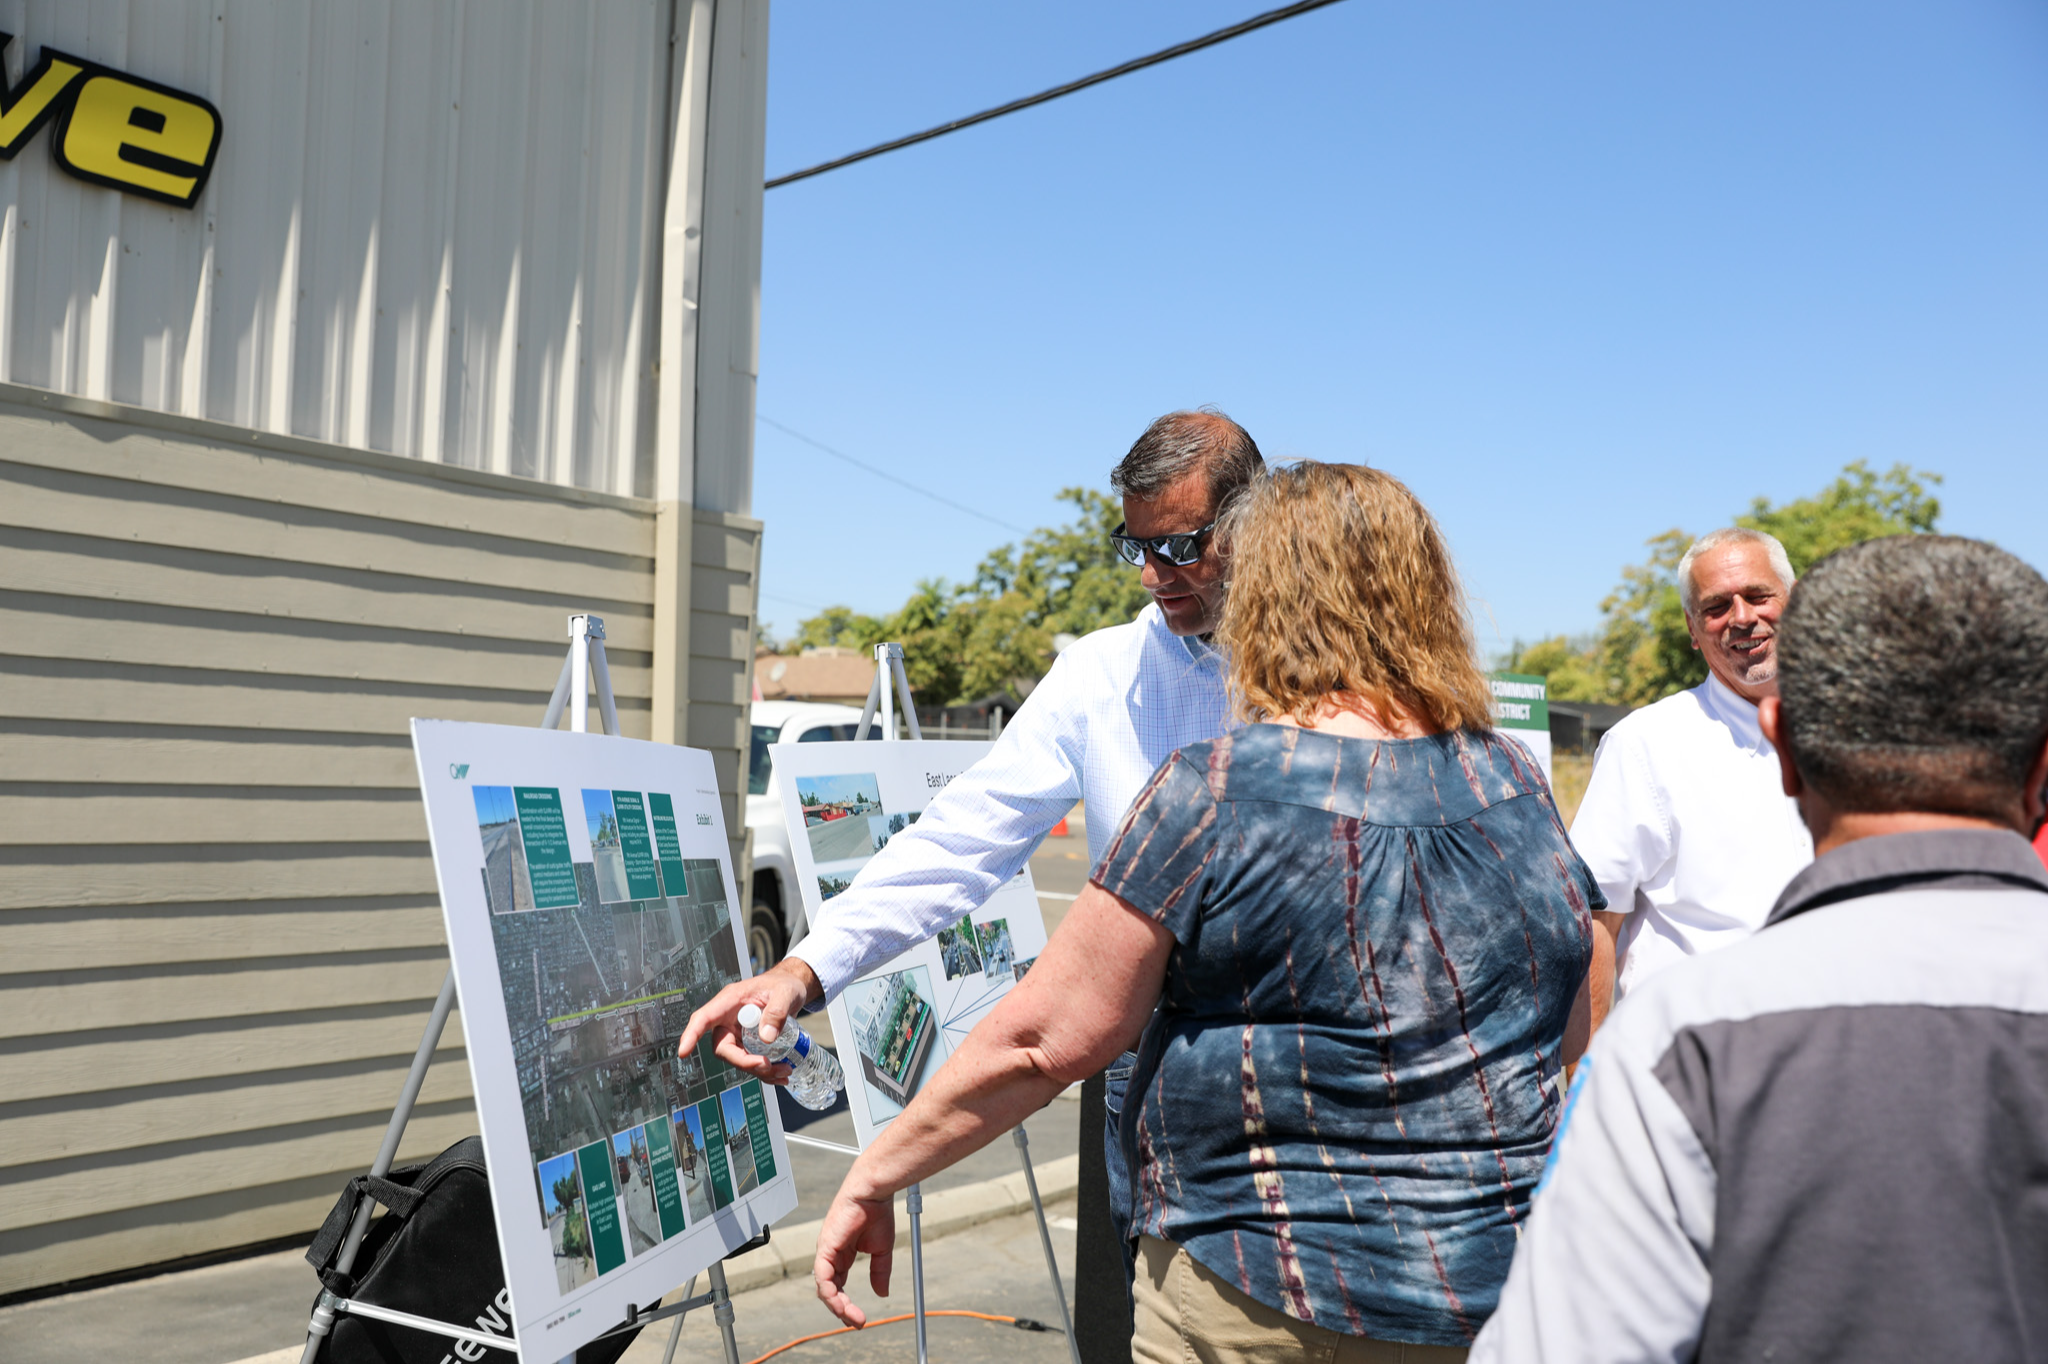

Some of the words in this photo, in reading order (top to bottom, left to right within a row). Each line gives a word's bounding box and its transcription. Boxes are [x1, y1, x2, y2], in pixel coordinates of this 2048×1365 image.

[1491, 681, 1546, 701] COMMUNITY
[926, 772, 943, 788] East
[696, 814, 710, 825] Exhibit
